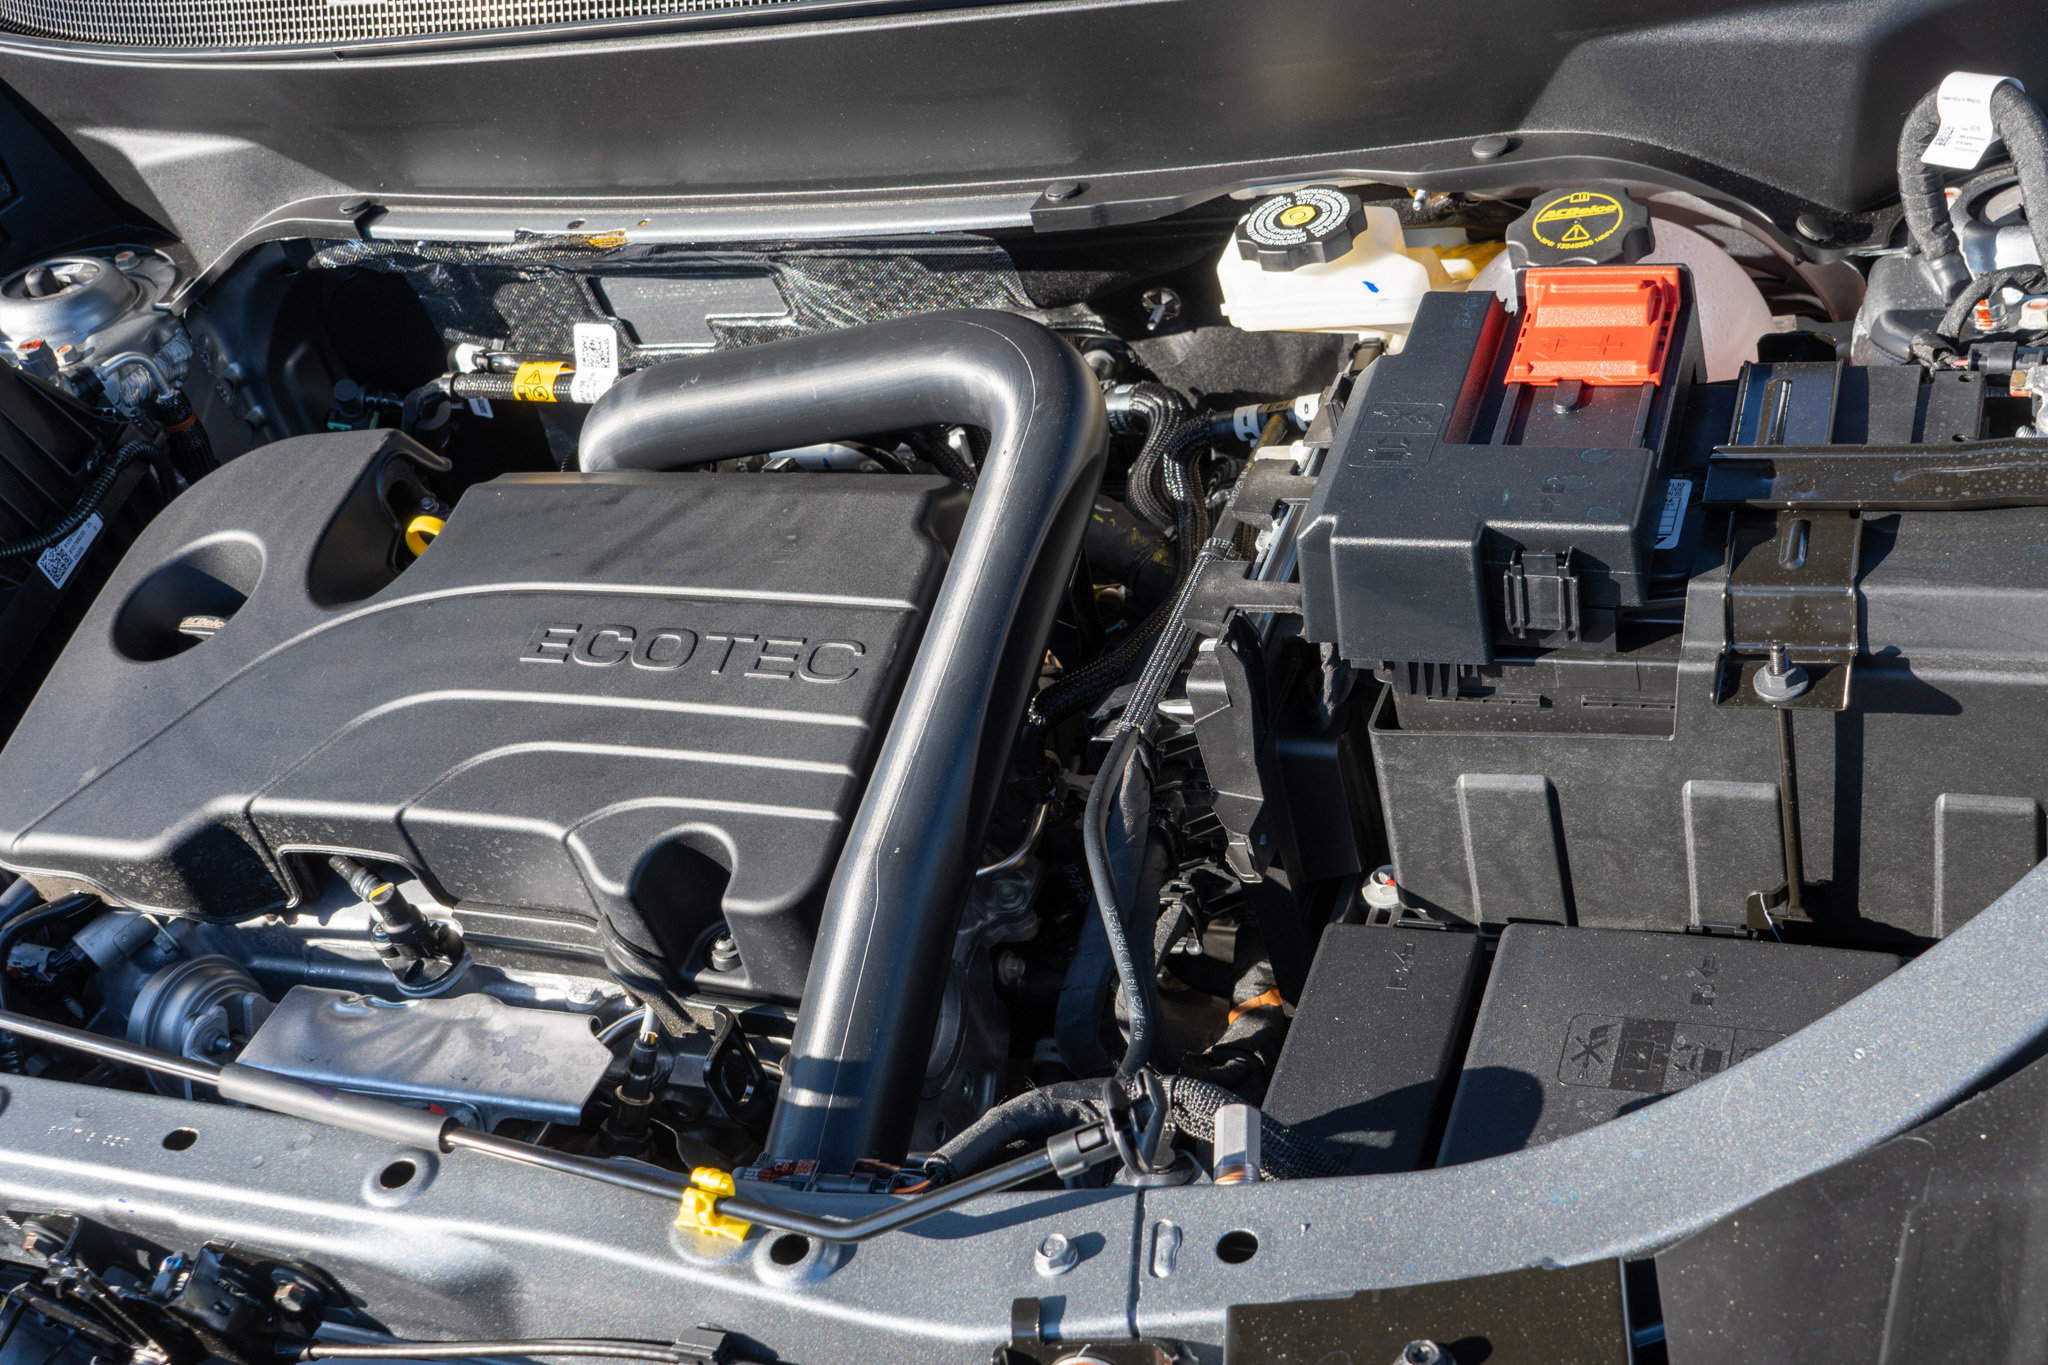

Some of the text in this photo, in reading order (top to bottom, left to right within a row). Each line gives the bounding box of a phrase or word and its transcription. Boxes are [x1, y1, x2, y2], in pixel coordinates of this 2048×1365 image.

[1540, 204, 1618, 220] ACDelco
[519, 622, 866, 684] ECOTEC
[1121, 961, 1139, 991] 04:10
